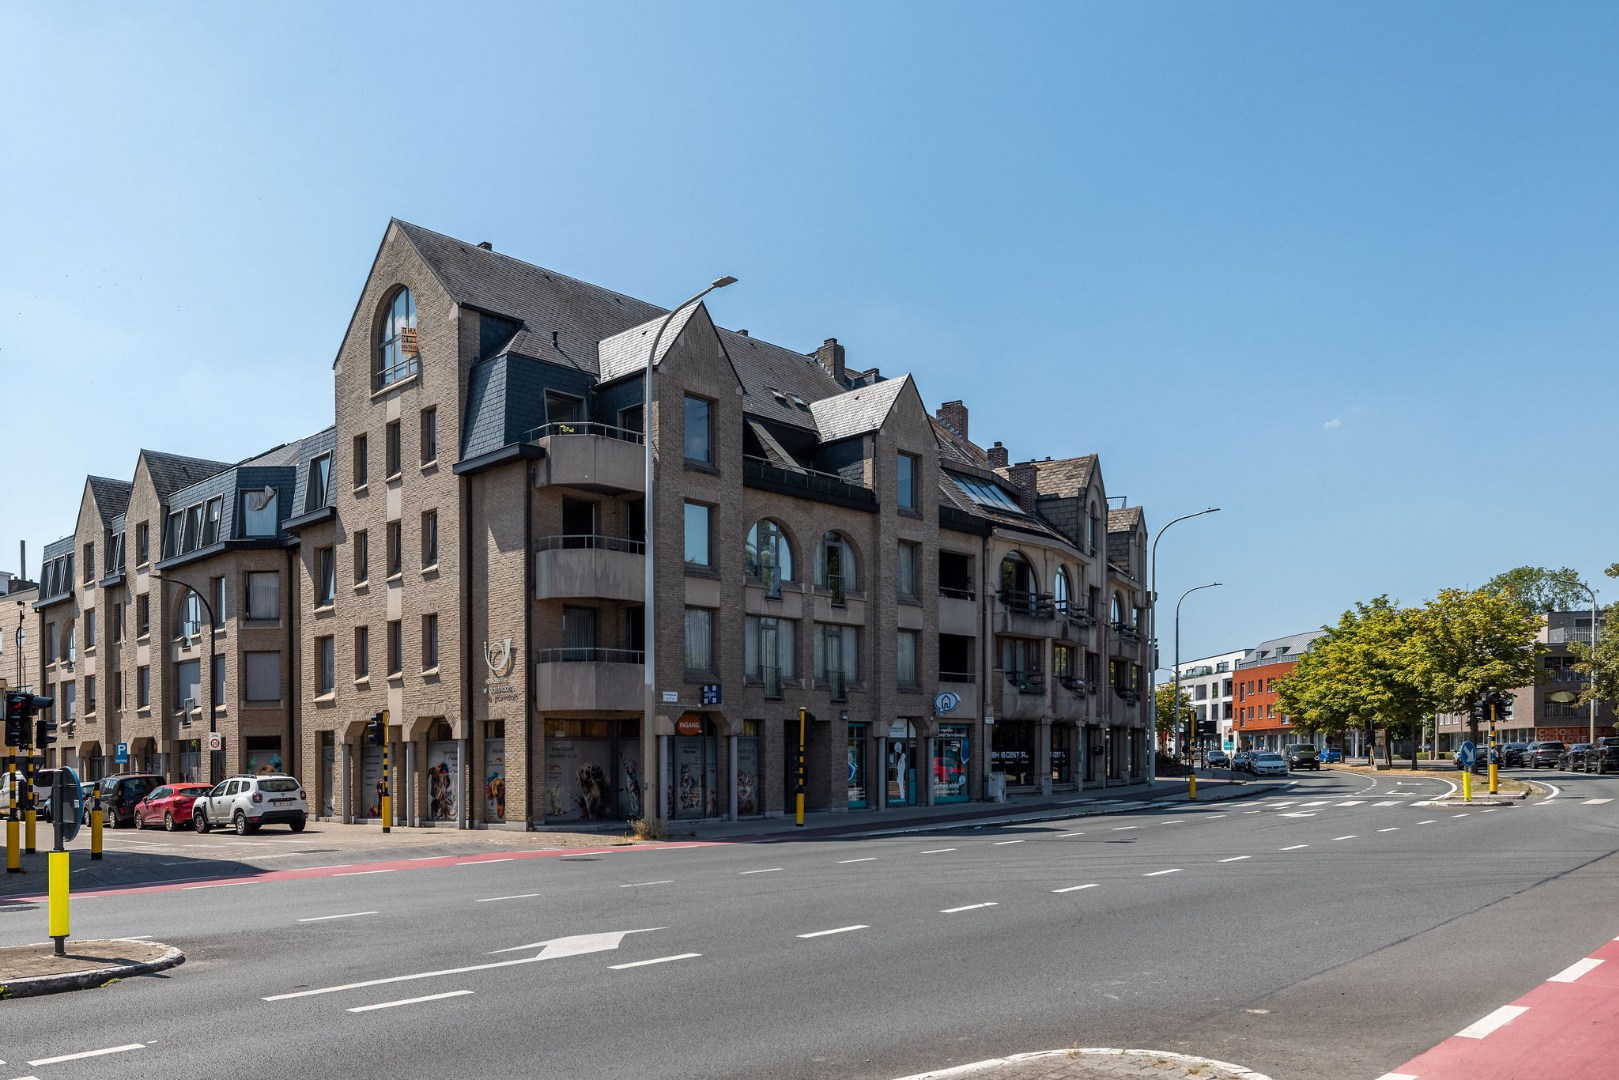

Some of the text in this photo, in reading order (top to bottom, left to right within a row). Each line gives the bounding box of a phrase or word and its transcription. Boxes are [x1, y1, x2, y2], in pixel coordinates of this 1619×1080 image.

[679, 721, 700, 729] INGANG
[1538, 728, 1578, 736] CHOOSE
[1562, 735, 1587, 743] LOVE
[118, 744, 126, 756] P
